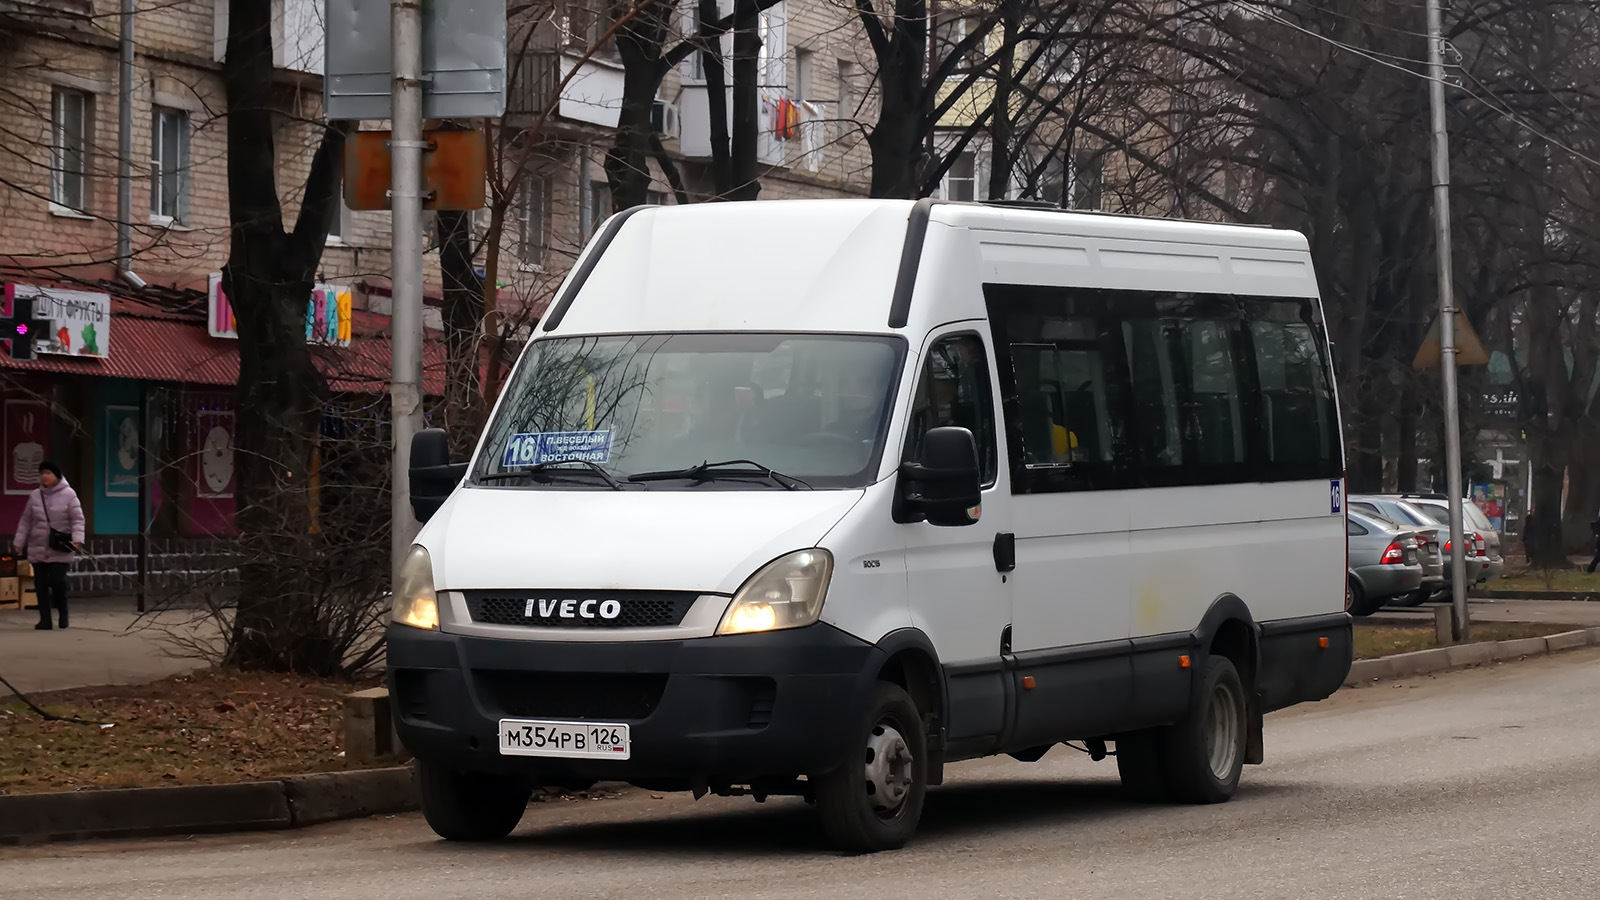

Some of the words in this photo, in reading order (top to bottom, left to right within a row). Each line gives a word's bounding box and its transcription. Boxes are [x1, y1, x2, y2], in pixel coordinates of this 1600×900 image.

[509, 437, 536, 462] 16
[540, 453, 604, 462] ВОСТОЧНАЯ
[1331, 486, 1340, 508] 16
[524, 598, 621, 619] IVECO
[590, 728, 620, 745] 126
[596, 744, 613, 752] RUS
